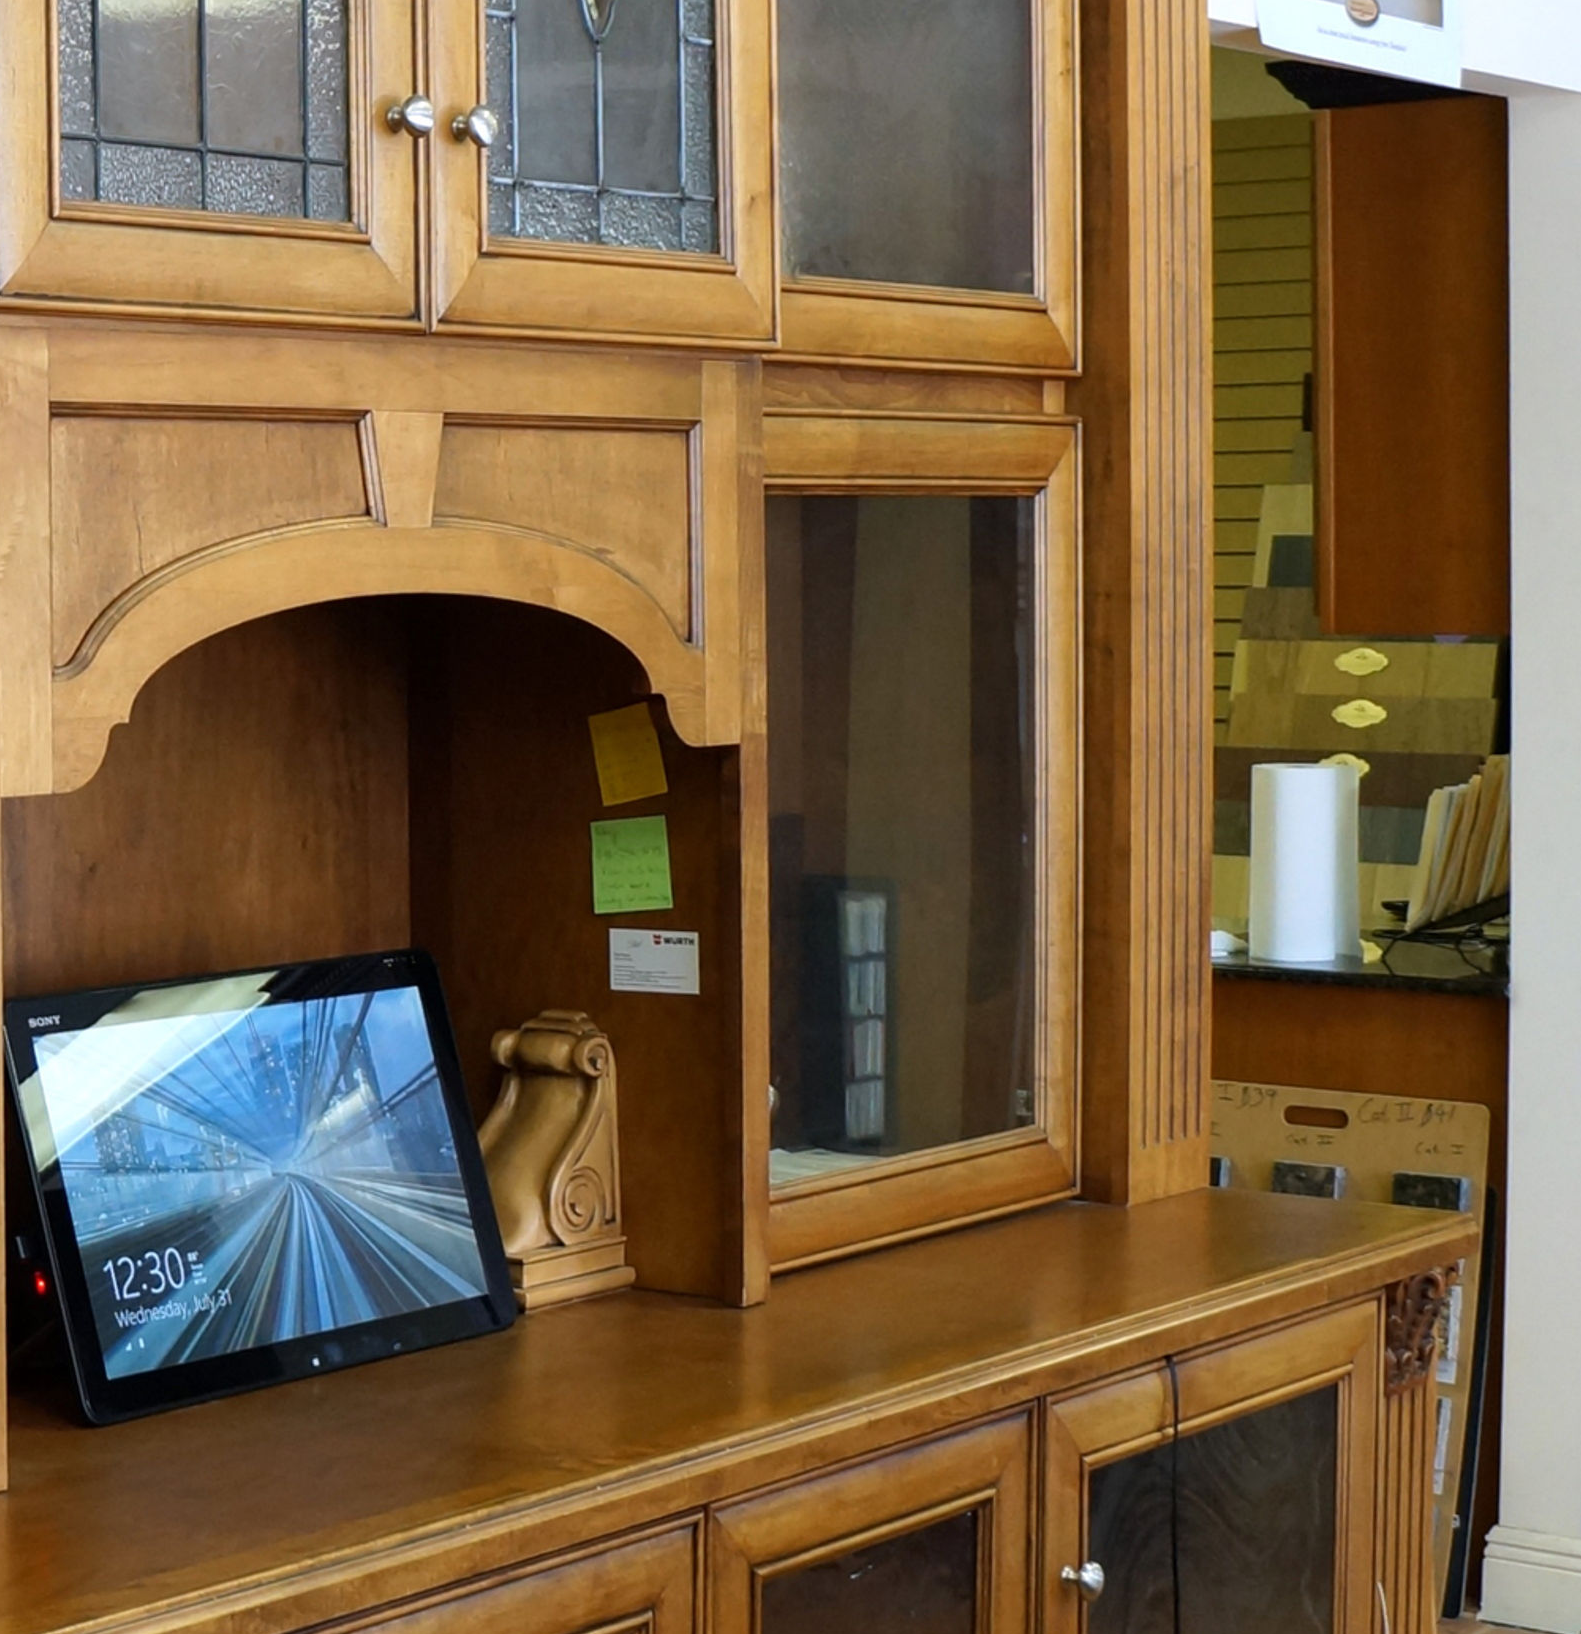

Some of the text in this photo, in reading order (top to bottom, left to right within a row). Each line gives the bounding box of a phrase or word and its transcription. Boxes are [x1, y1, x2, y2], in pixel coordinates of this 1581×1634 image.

[28, 1015, 61, 1028] SONY
[103, 1247, 185, 1300] 12:30
[114, 1288, 233, 1328] Wednesday, July 31
